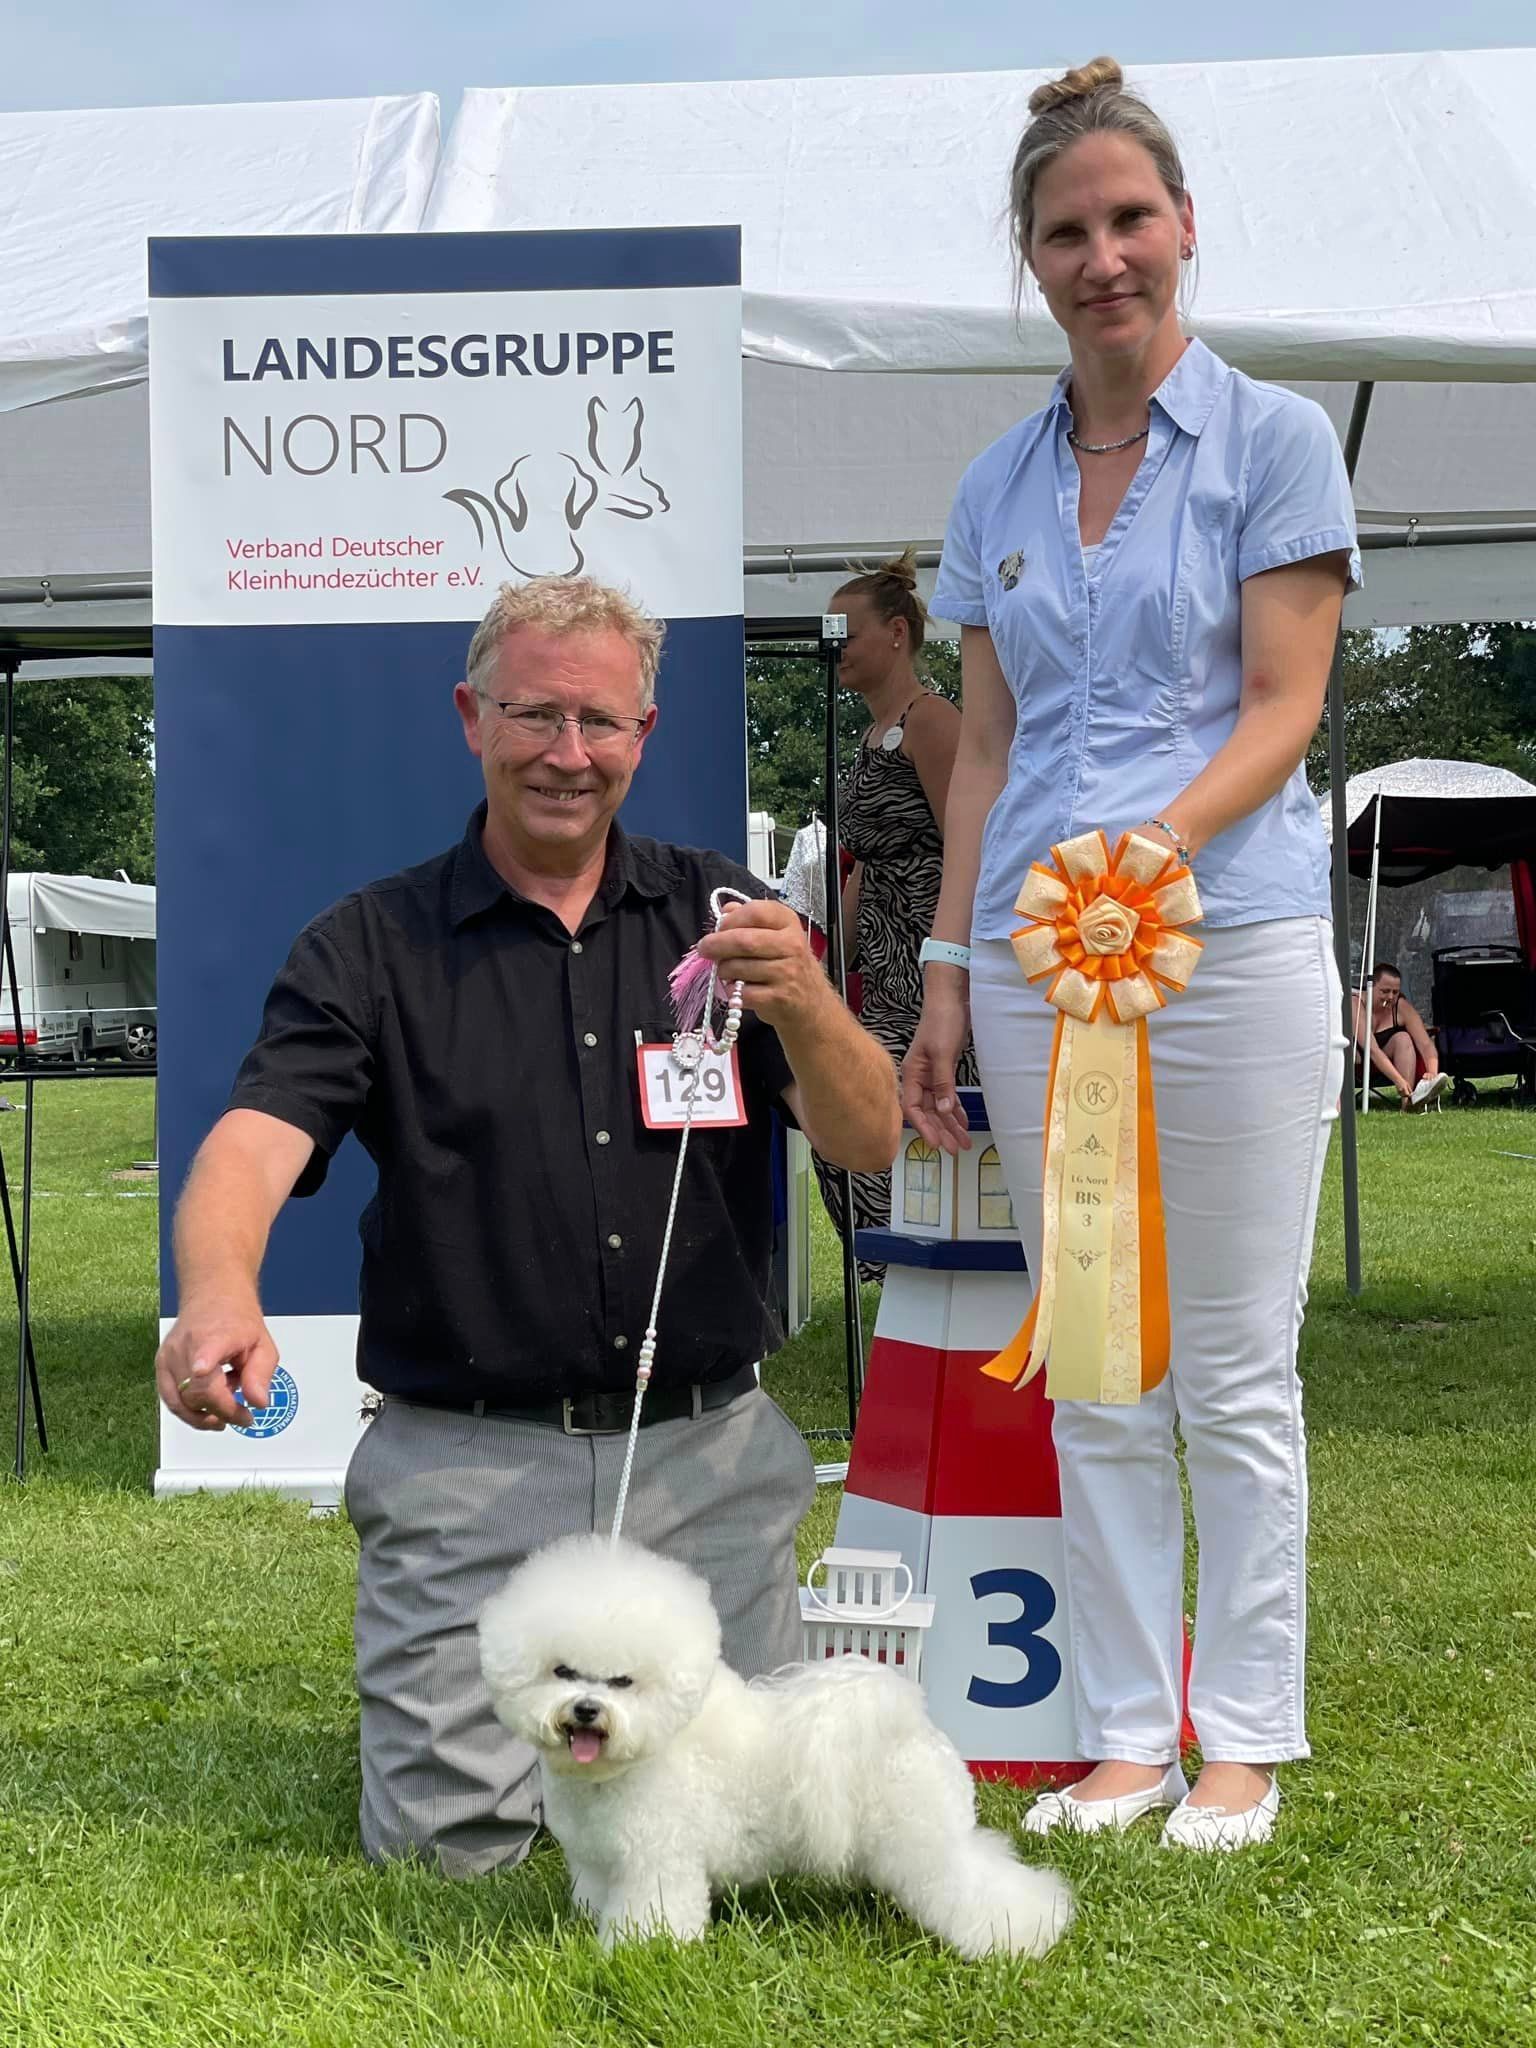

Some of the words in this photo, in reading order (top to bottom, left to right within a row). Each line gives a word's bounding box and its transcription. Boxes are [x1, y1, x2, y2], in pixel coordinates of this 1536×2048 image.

[223, 331, 674, 381] LANDESGRUPPE
[224, 413, 447, 476] NORD
[226, 537, 322, 558] Verband
[332, 535, 444, 557] Deutscher
[228, 567, 438, 590] Kleinhundezüchter
[447, 566, 484, 587] e.V.
[655, 1067, 726, 1102] 129
[1086, 1174, 1108, 1185] Nord
[1075, 1191, 1101, 1206] BIS
[1082, 1214, 1092, 1227] 3
[272, 1371, 297, 1434] INTERNATIONALE
[967, 1568, 1062, 1708] 3
